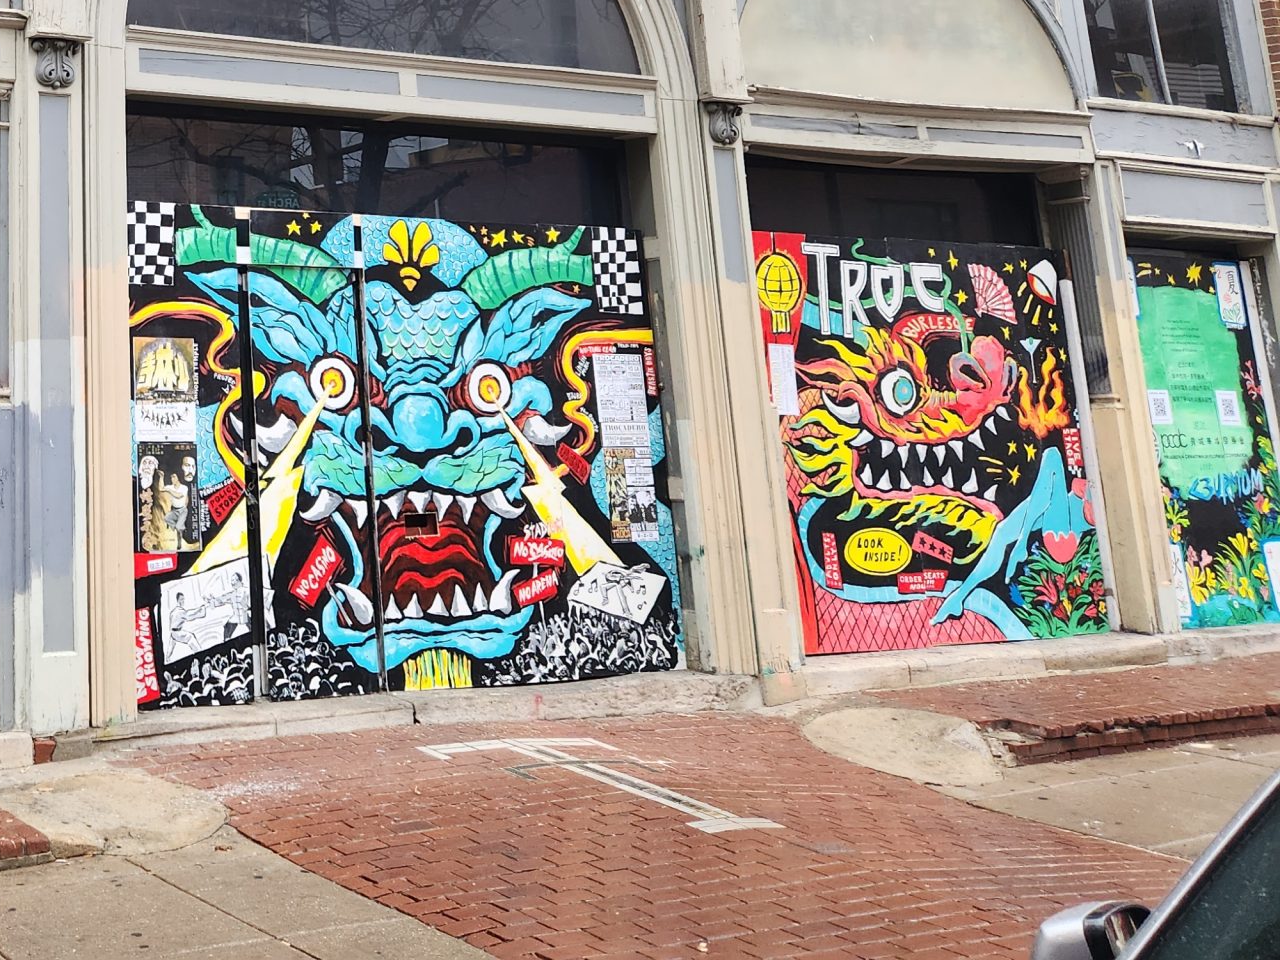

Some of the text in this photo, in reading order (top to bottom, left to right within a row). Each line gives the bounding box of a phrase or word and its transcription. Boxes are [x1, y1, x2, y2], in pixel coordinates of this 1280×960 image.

[801, 242, 945, 339] TROC
[901, 317, 974, 339] BURLESQE
[1063, 428, 1075, 465] STAGE
[1070, 428, 1081, 460] LIVE
[210, 484, 238, 507] POLICE
[215, 489, 241, 518] STORY
[823, 535, 833, 579] ADULTS
[857, 538, 884, 548] LOOK
[864, 545, 902, 562] INSIDE!
[309, 545, 335, 590] CASINO
[831, 548, 839, 580] ONLY
[900, 572, 945, 583] ORDER SEATS
[519, 570, 559, 603] NO ARENA
[138, 608, 159, 691] SHOWING
